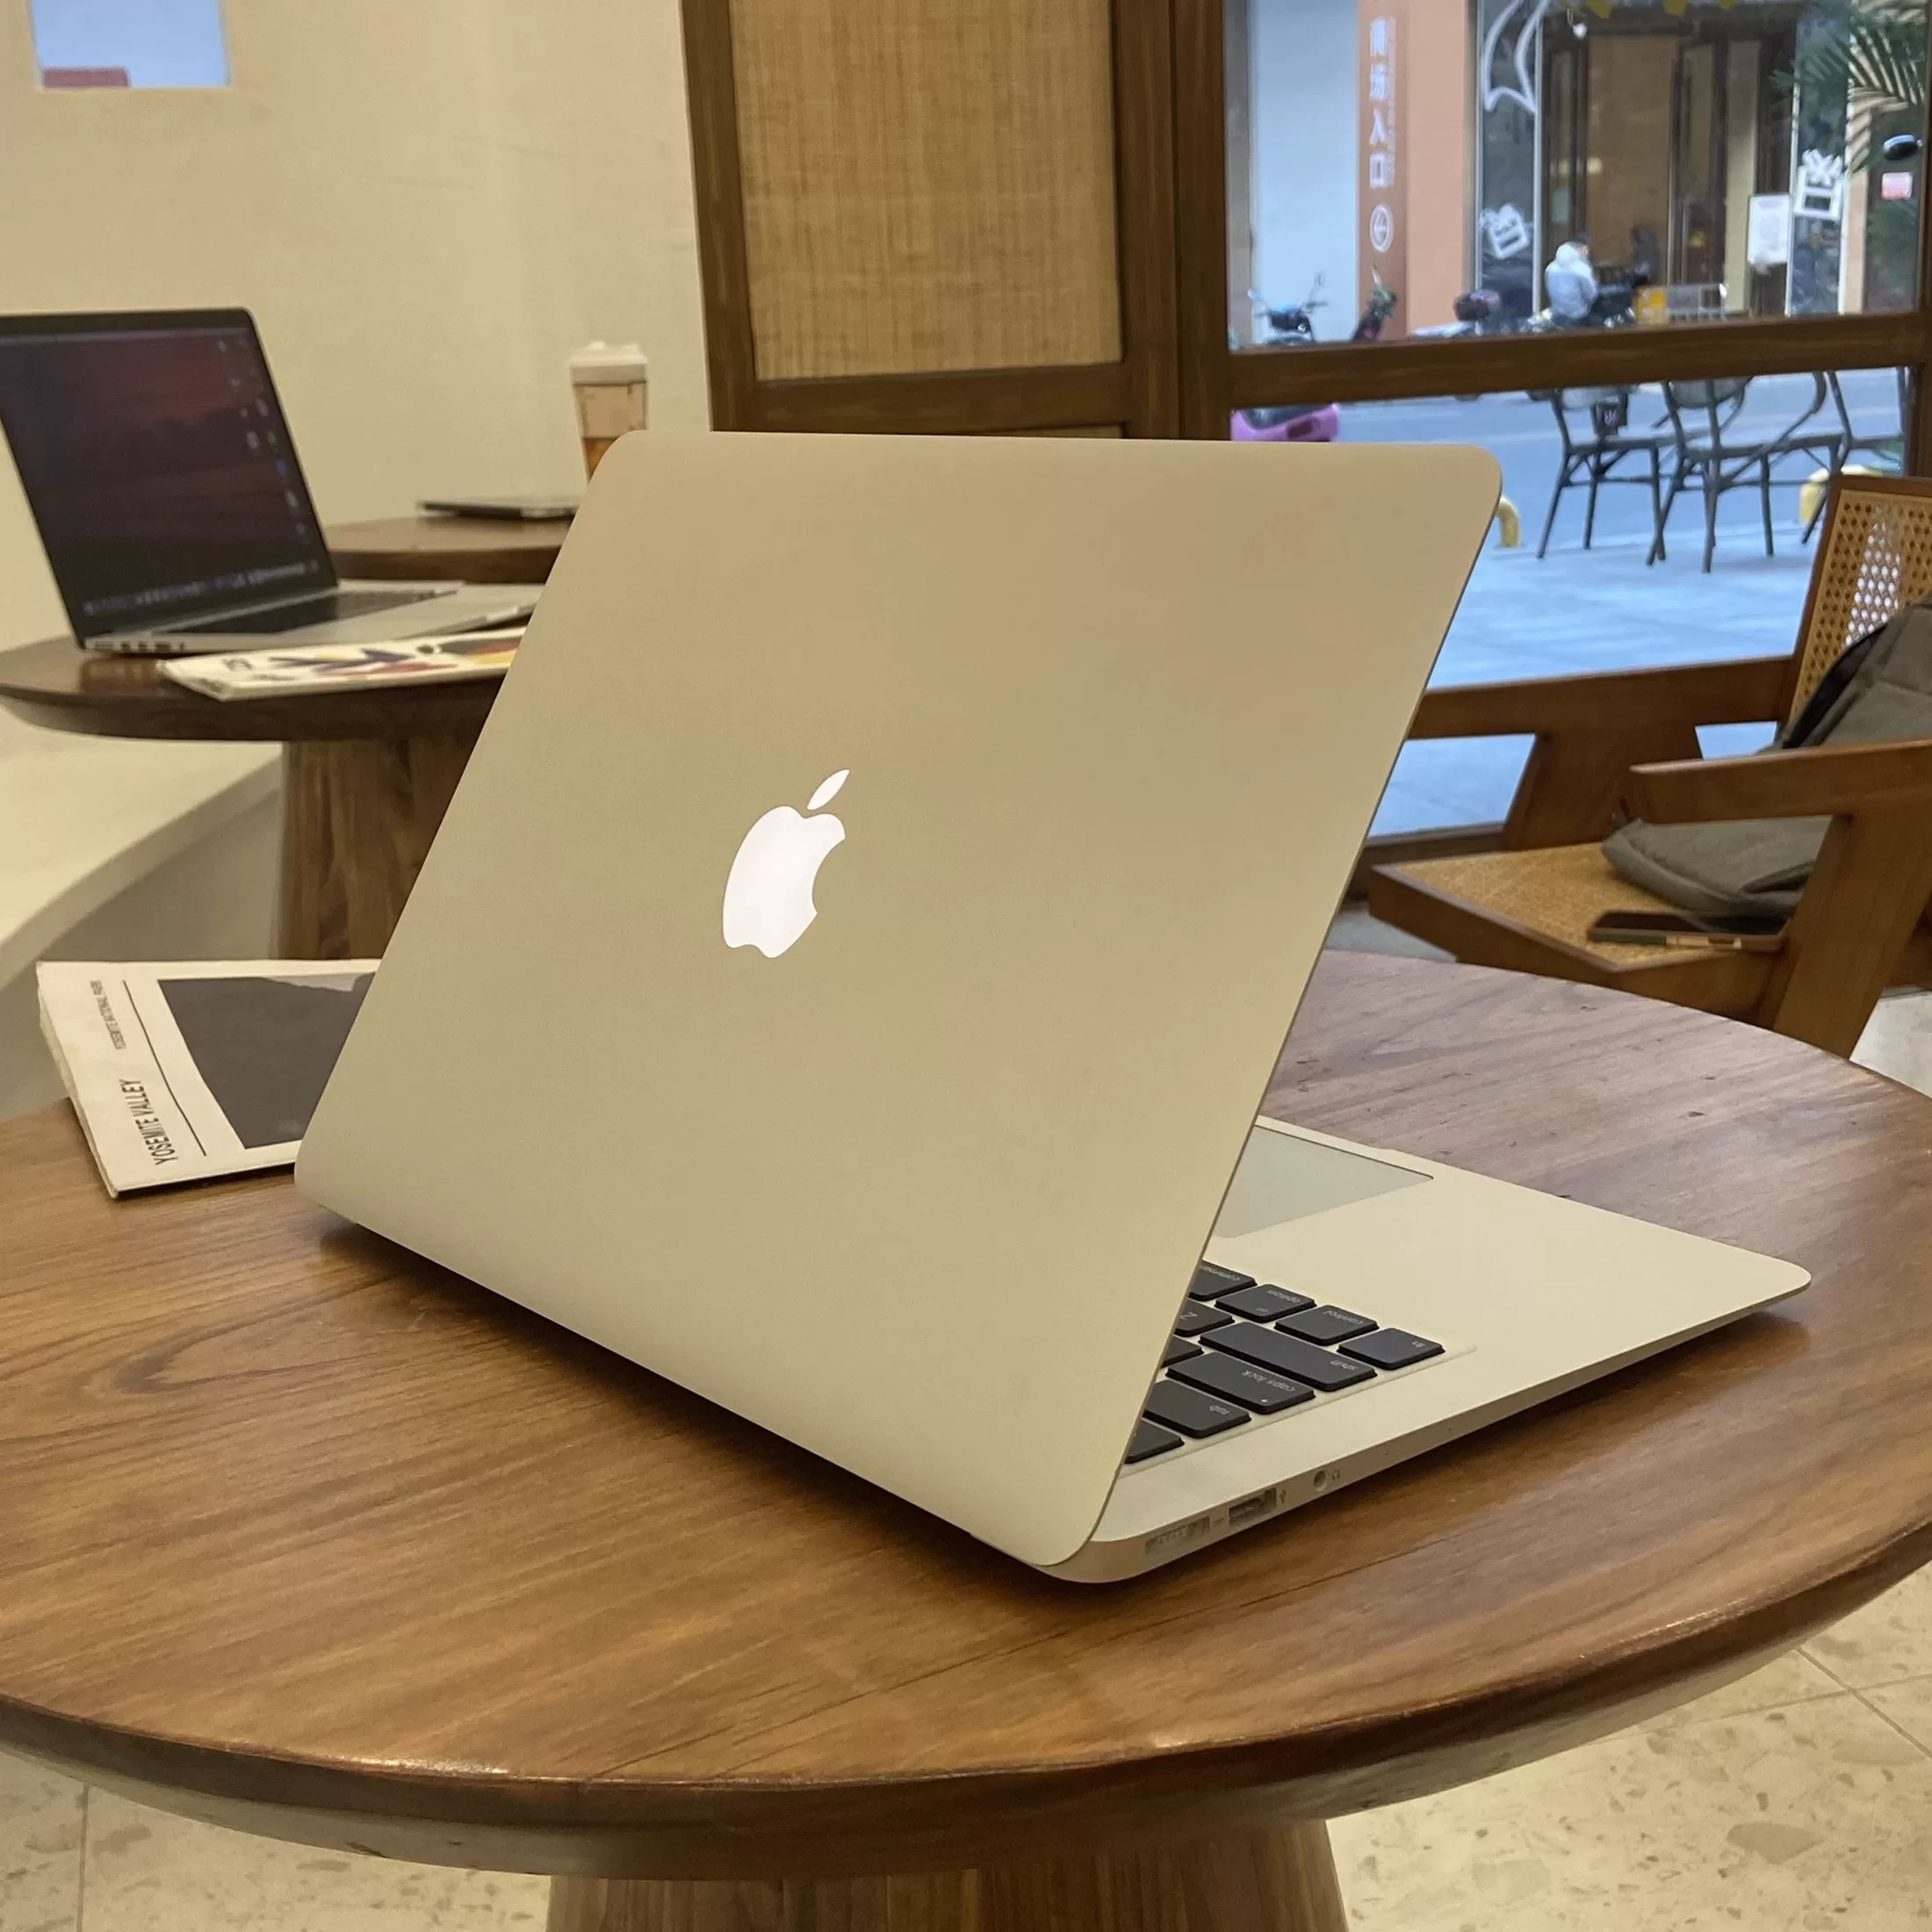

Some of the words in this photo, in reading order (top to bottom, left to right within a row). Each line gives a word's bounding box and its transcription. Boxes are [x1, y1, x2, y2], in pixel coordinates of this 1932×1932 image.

[119, 1078, 155, 1117] VALLEY
[135, 1117, 178, 1165] YOSEMITE
[1266, 1289, 1301, 1303] option
[1323, 1310, 1364, 1325] control
[1330, 1359, 1358, 1371] shift
[1241, 1369, 1266, 1384] lock
[1266, 1379, 1295, 1393] caps
[1209, 1404, 1230, 1416] tab
